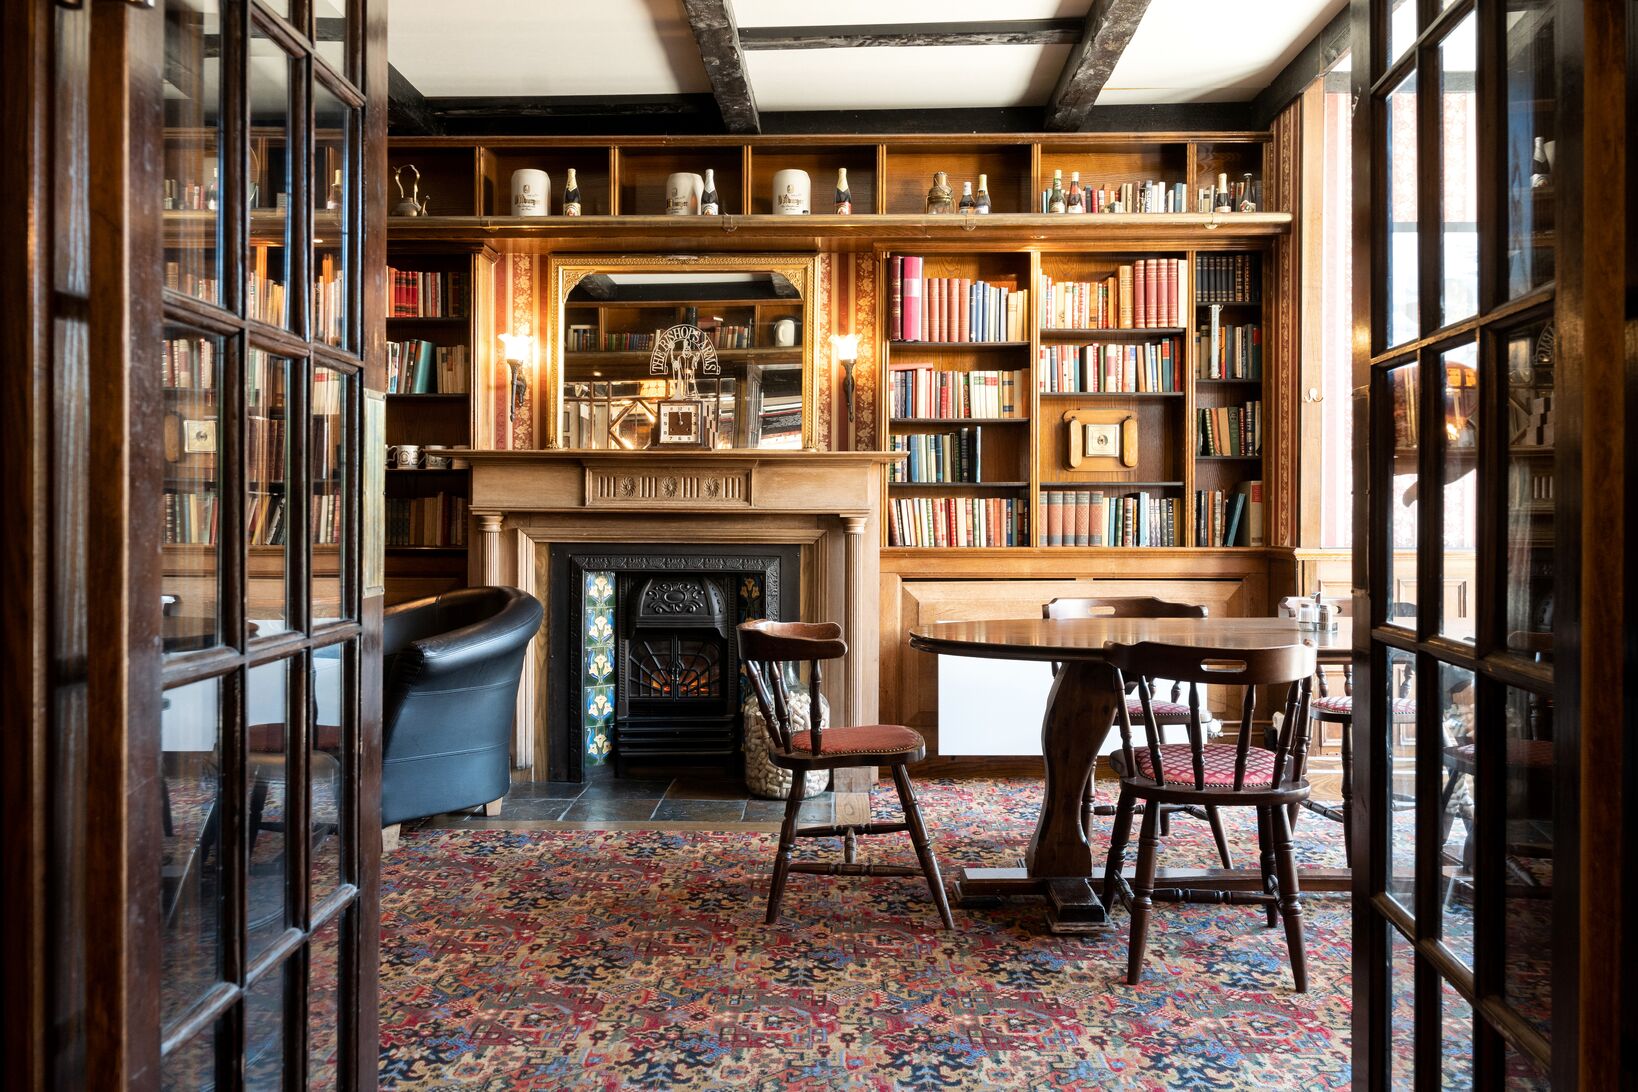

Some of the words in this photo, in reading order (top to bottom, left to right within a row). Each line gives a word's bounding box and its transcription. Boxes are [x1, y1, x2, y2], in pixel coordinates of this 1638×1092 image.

[652, 348, 666, 372] THE
[659, 326, 702, 352] BISHOPS
[699, 339, 717, 371] ARMS
